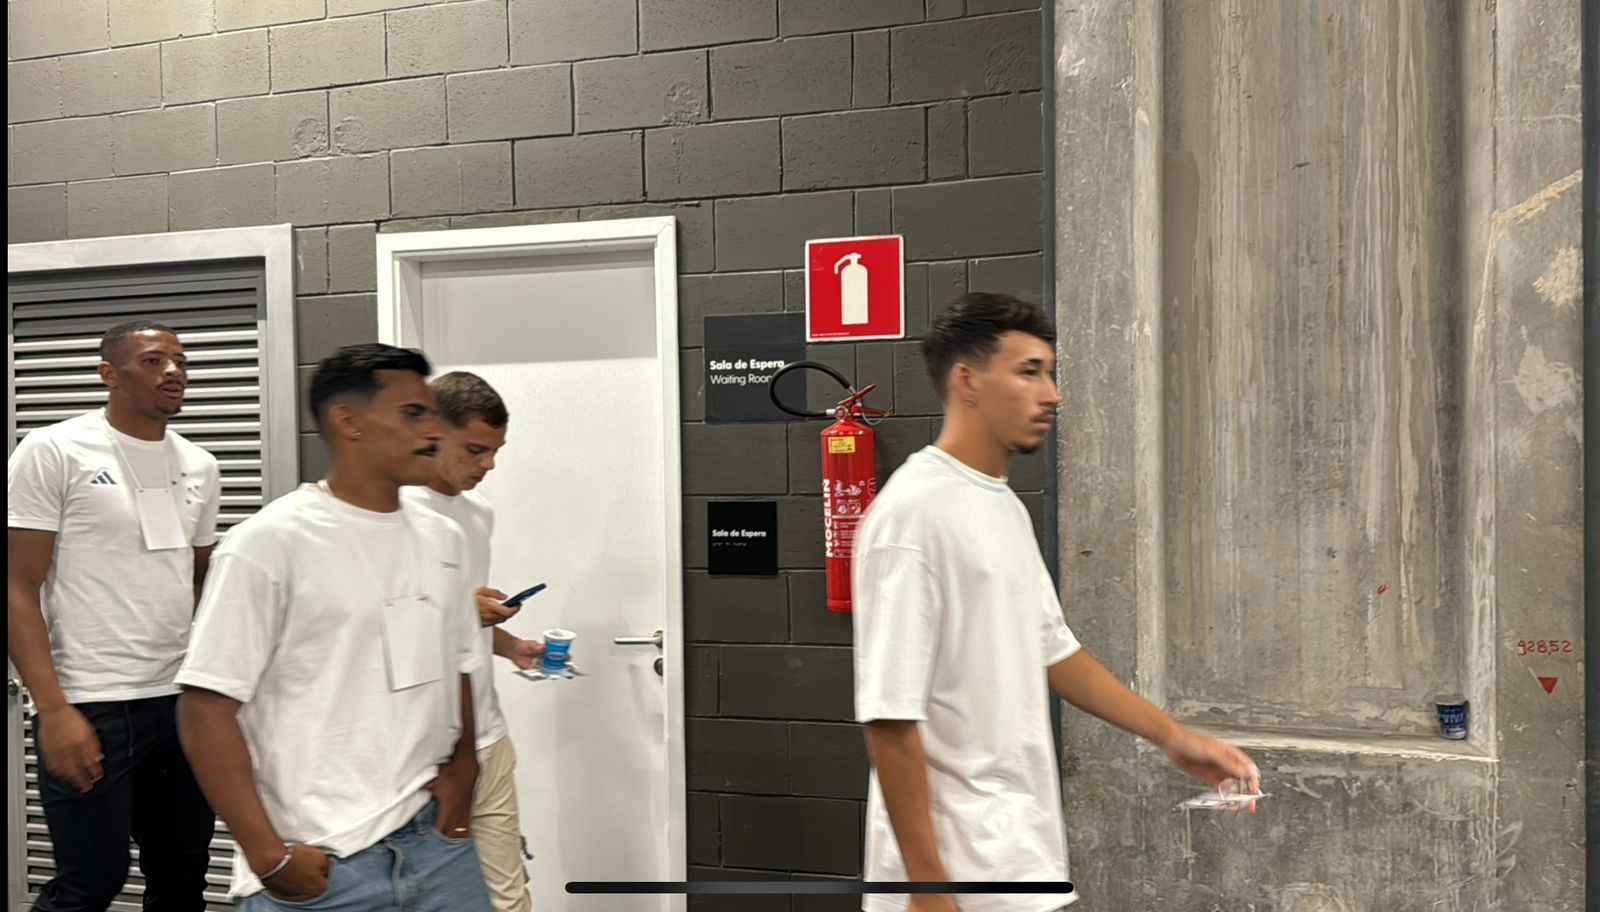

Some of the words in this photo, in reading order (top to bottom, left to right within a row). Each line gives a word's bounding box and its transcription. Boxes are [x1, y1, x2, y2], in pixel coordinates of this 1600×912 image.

[710, 359, 733, 370] Sala
[734, 359, 748, 369] de
[749, 359, 785, 371] Espera
[710, 374, 746, 386] Waiting
[823, 478, 833, 558] MOCELIN
[712, 529, 729, 537] Sala
[730, 529, 740, 537] de
[741, 529, 767, 538] Espera
